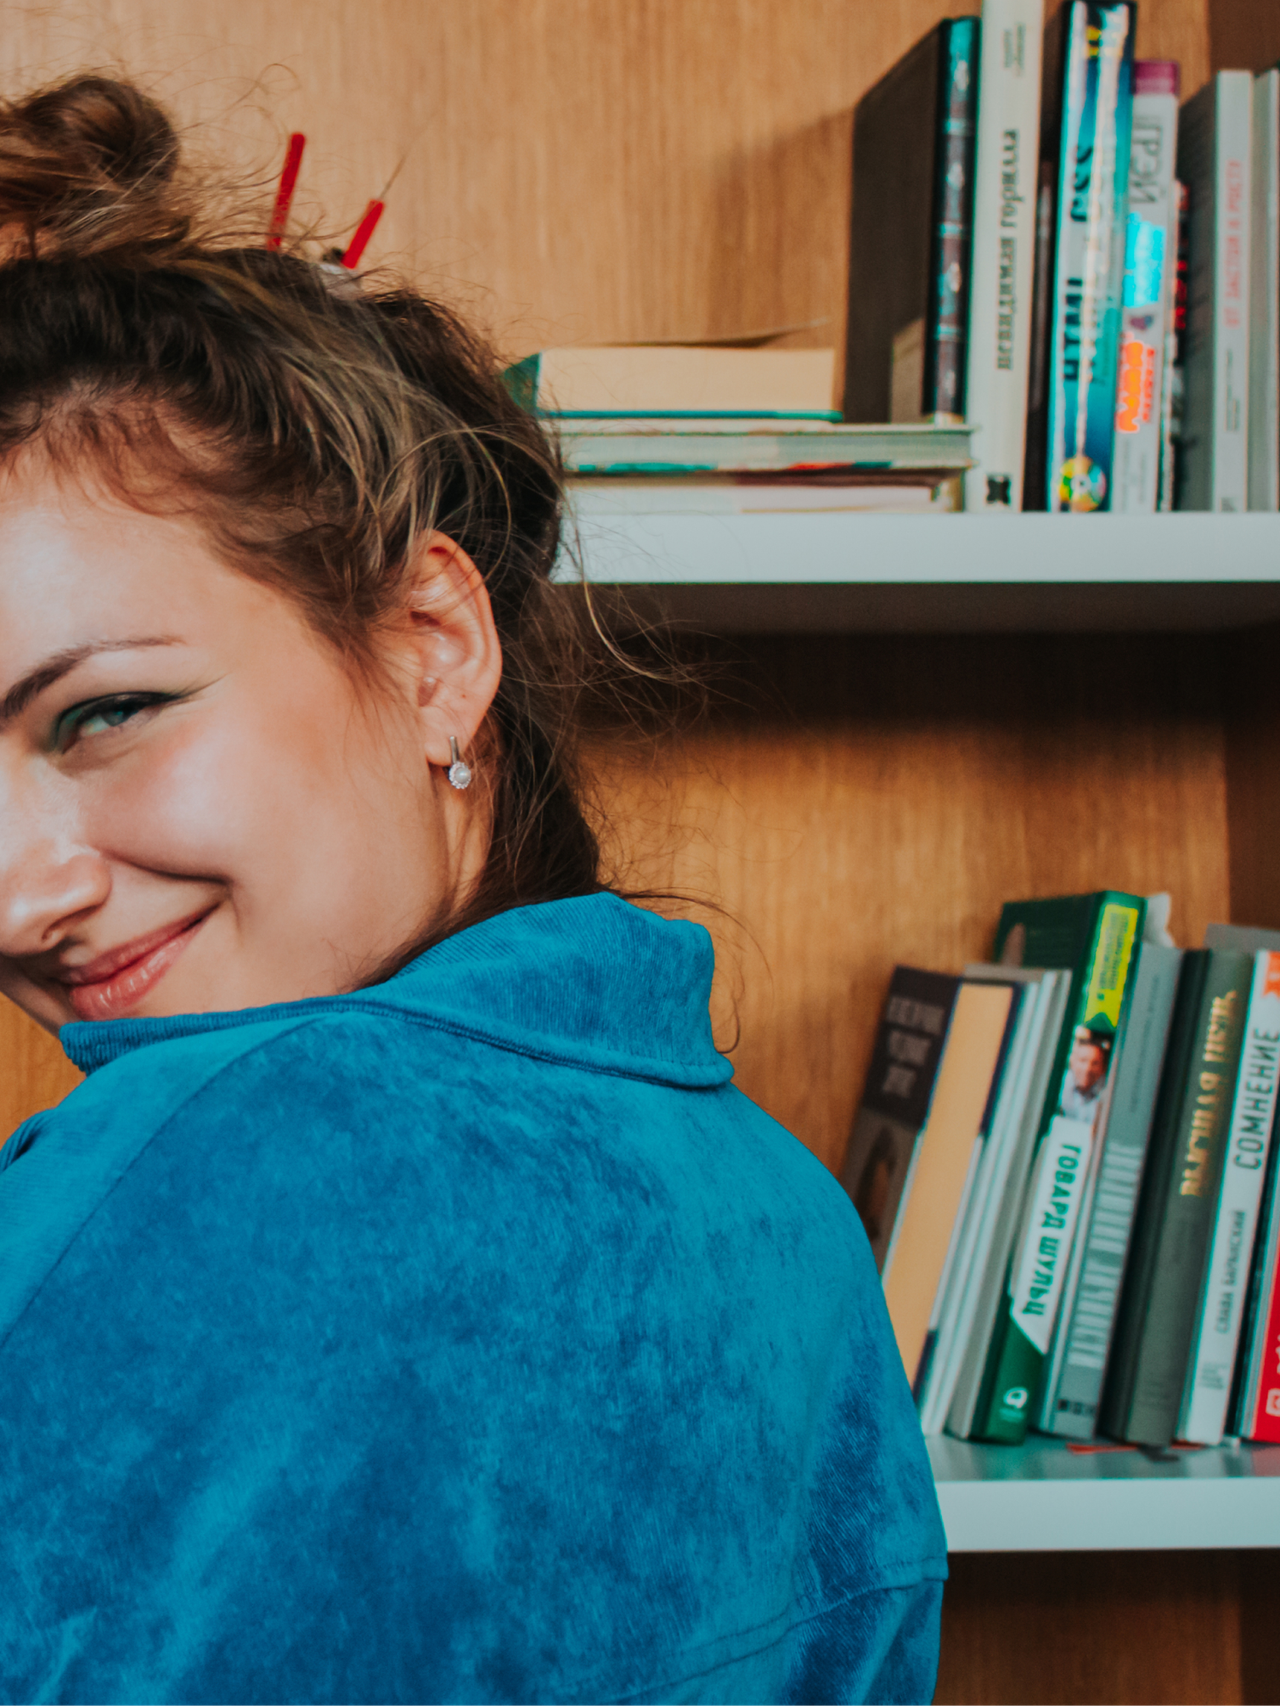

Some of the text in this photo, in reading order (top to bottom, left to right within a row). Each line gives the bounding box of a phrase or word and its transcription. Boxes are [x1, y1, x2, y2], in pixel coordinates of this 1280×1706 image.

[1234, 1028, 1280, 1171] СОМНЕНИЕ
[1022, 1145, 1082, 1317] ГОВАРД ШУЛЬЦ
